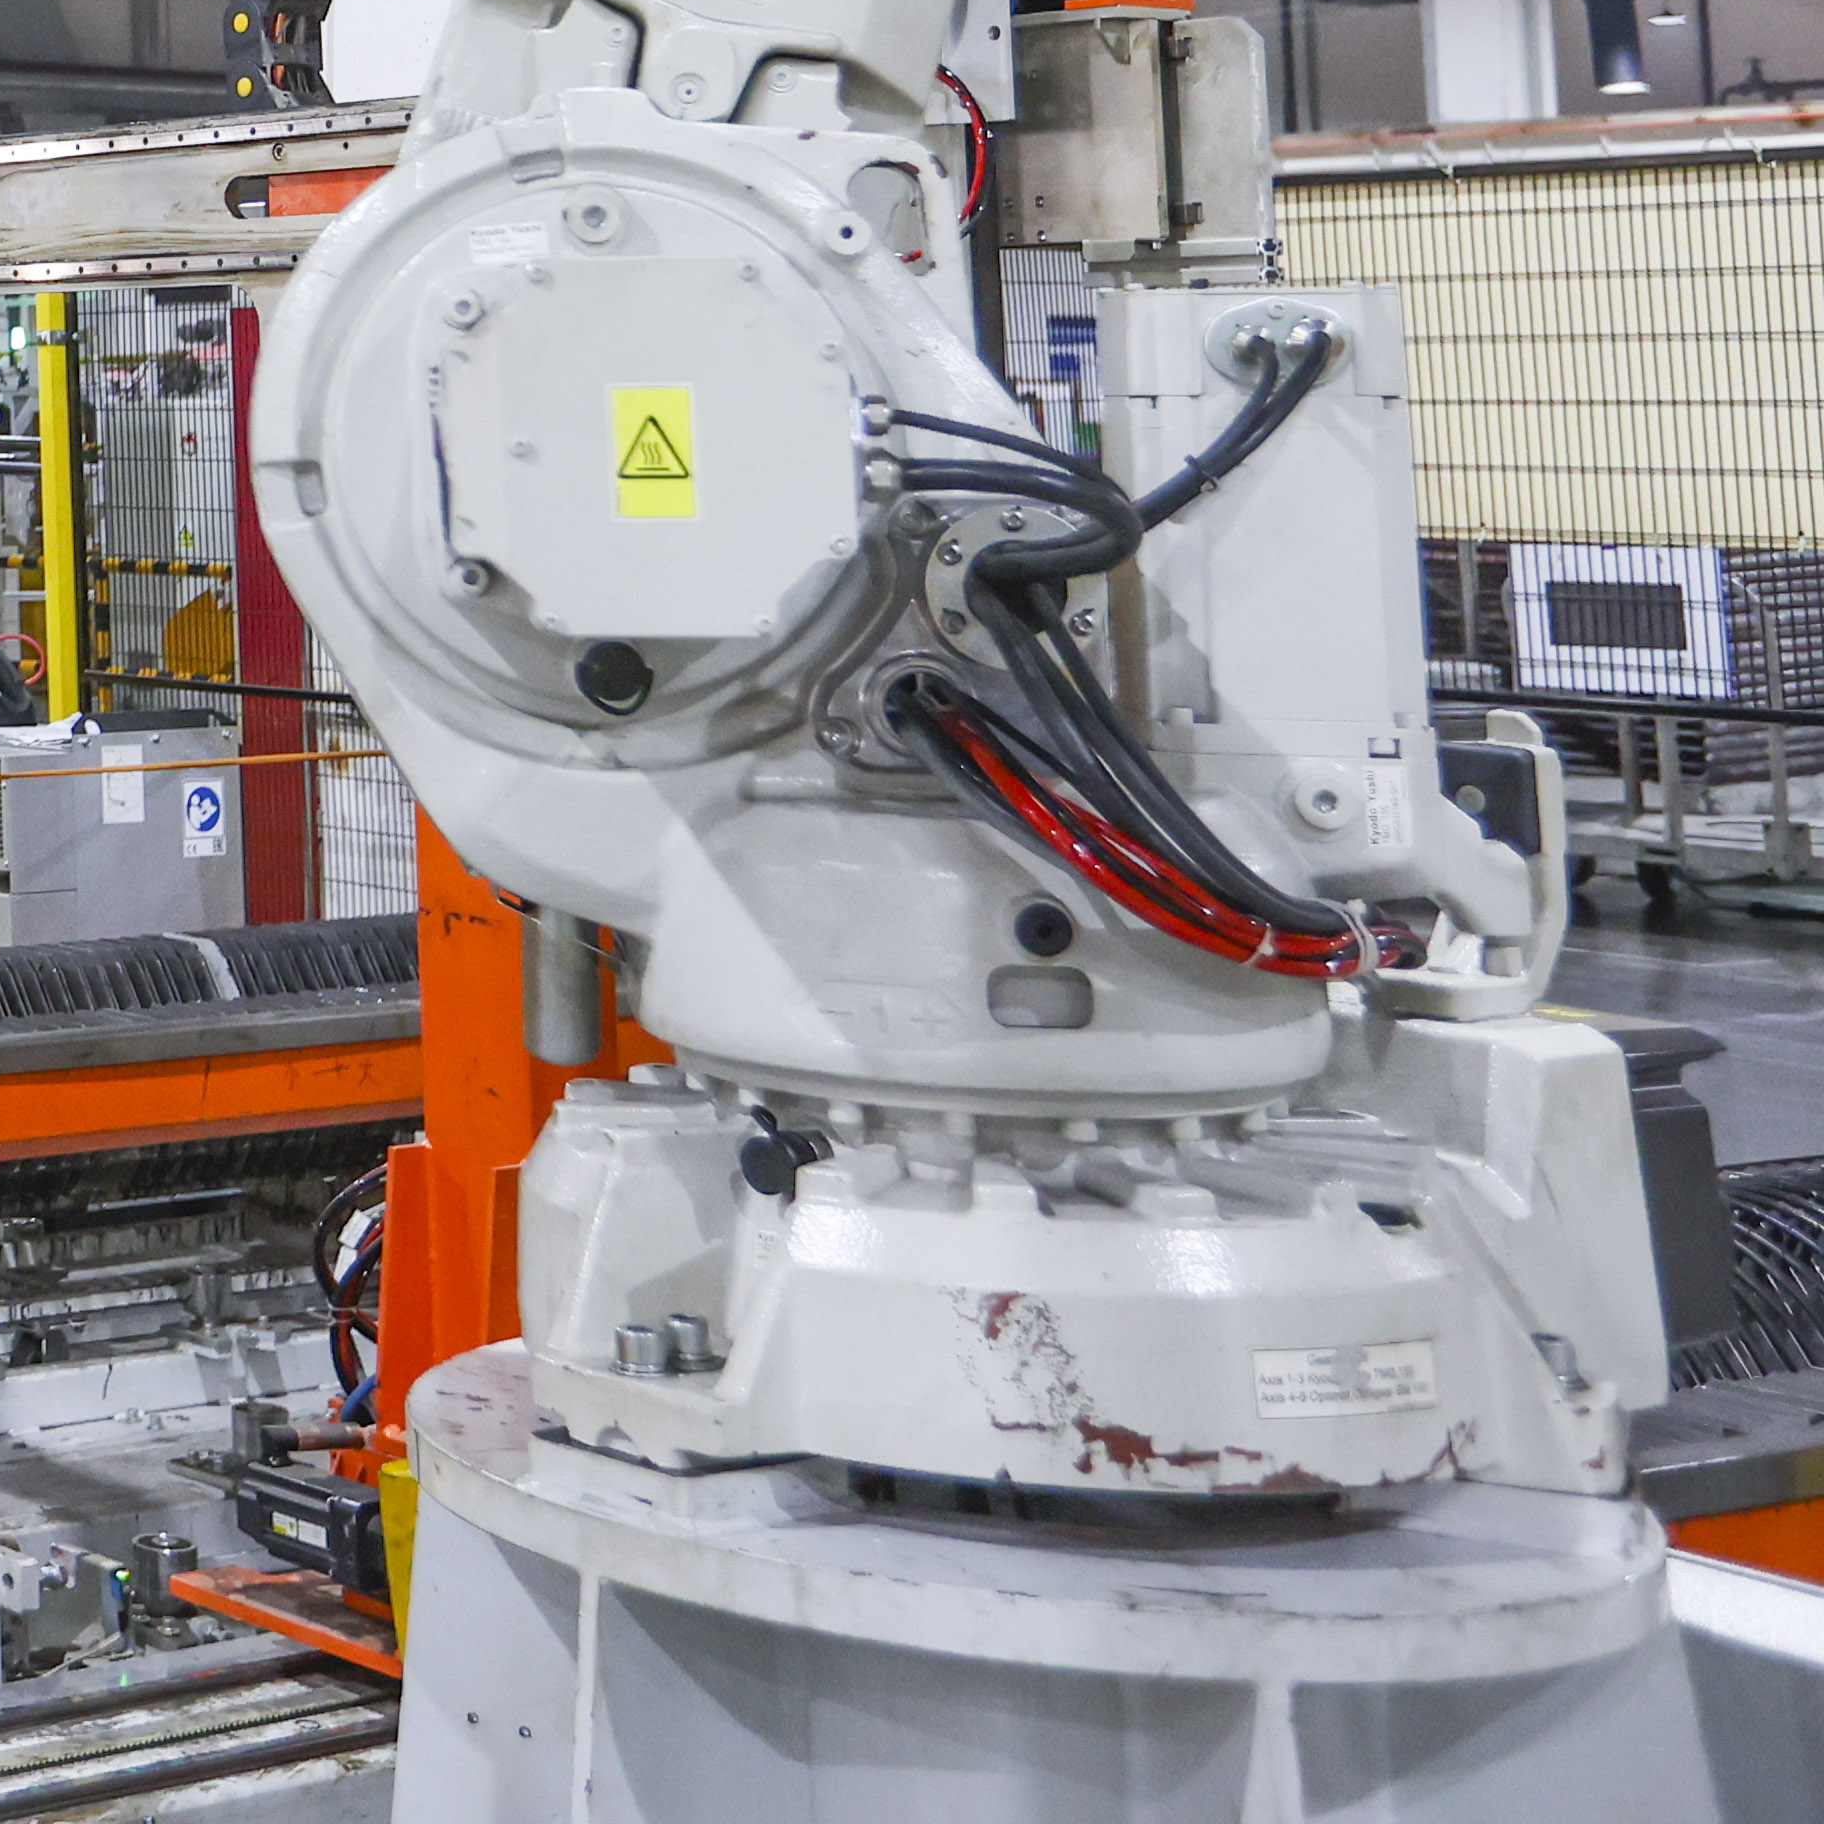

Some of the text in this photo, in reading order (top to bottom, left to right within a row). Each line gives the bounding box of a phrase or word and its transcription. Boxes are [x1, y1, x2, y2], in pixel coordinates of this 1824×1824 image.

[1368, 807, 1381, 845] Kyodo
[1259, 1373, 1283, 1386] Axis
[1261, 1390, 1286, 1403] Axis
